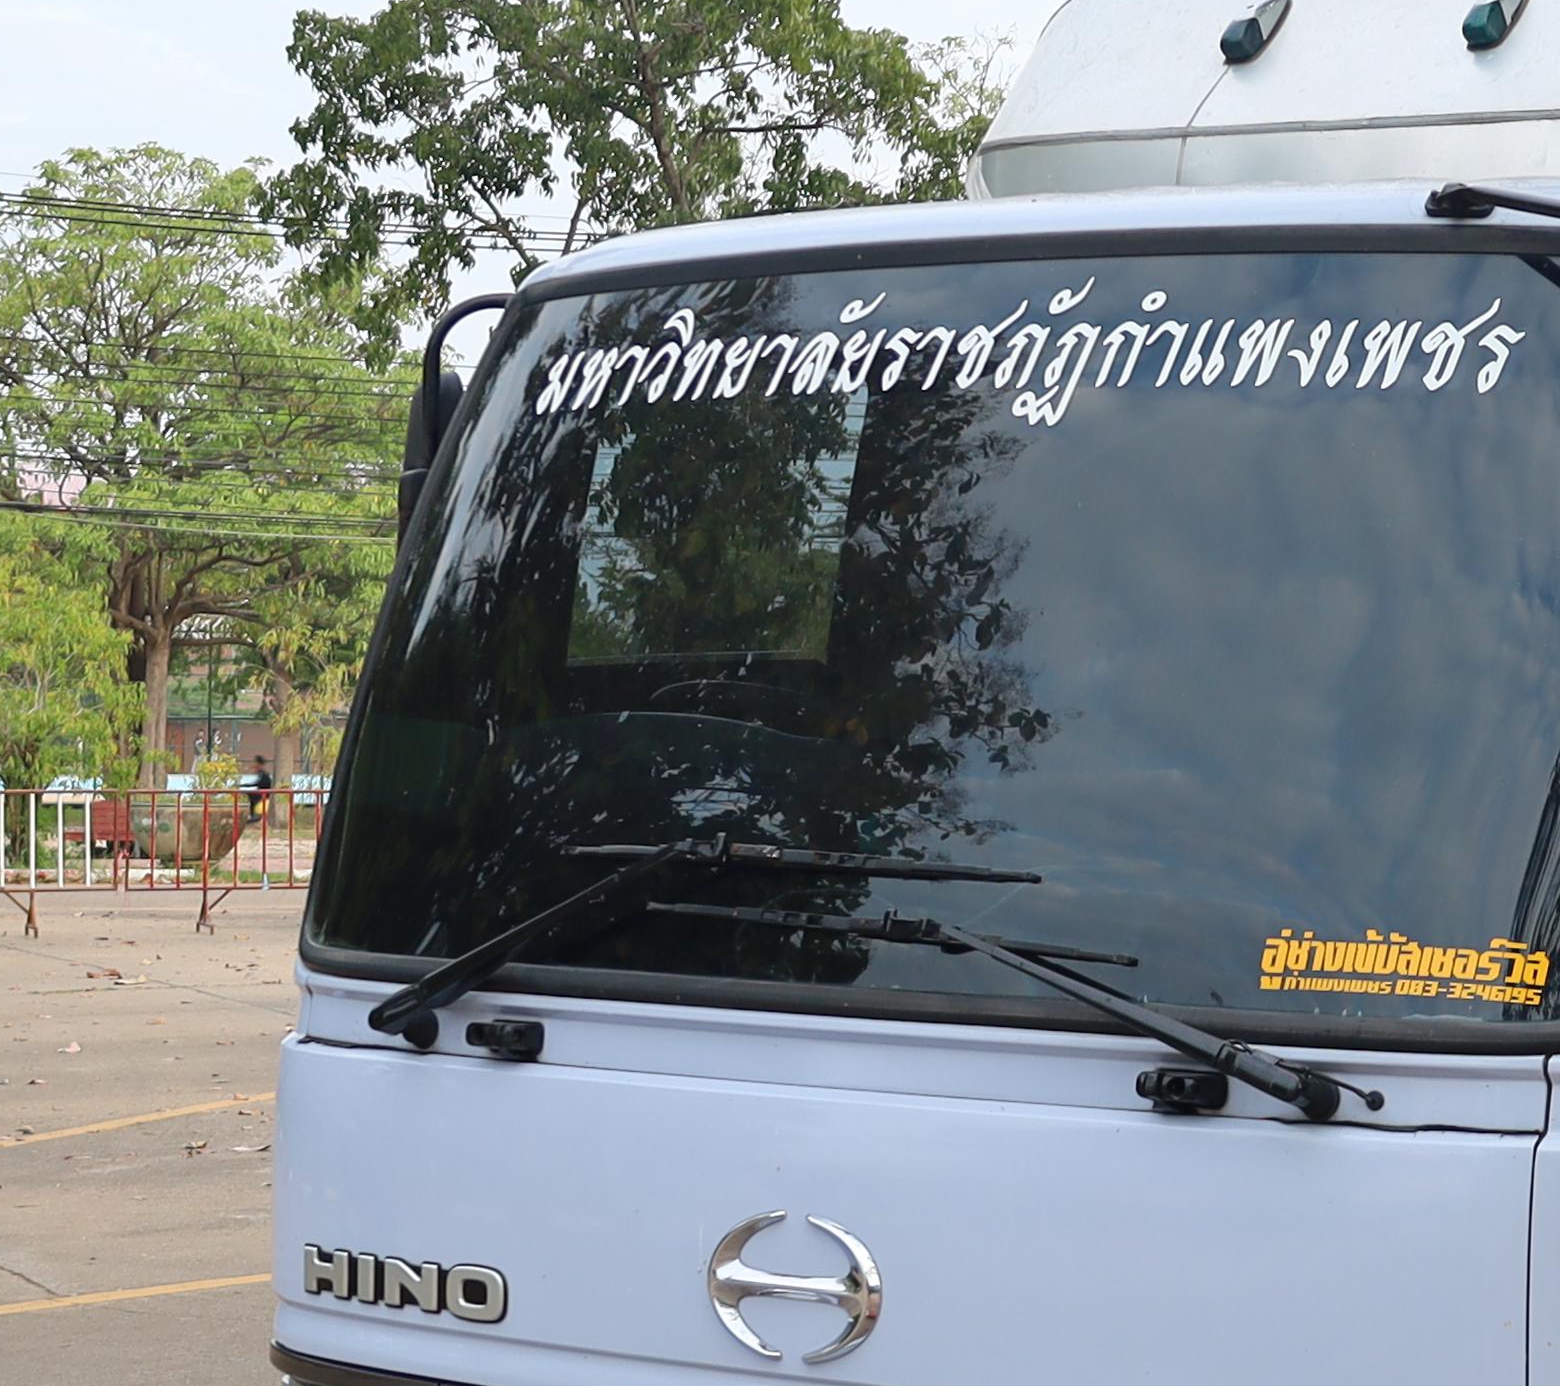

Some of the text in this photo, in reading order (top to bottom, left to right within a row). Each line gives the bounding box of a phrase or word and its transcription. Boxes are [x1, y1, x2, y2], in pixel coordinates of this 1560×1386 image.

[536, 276, 1526, 428] มหาวิทยาลัยราชภัฏกำแพงเพชร
[1283, 971, 1393, 995] กำแพงเพชร
[303, 1243, 509, 1323] HINO
